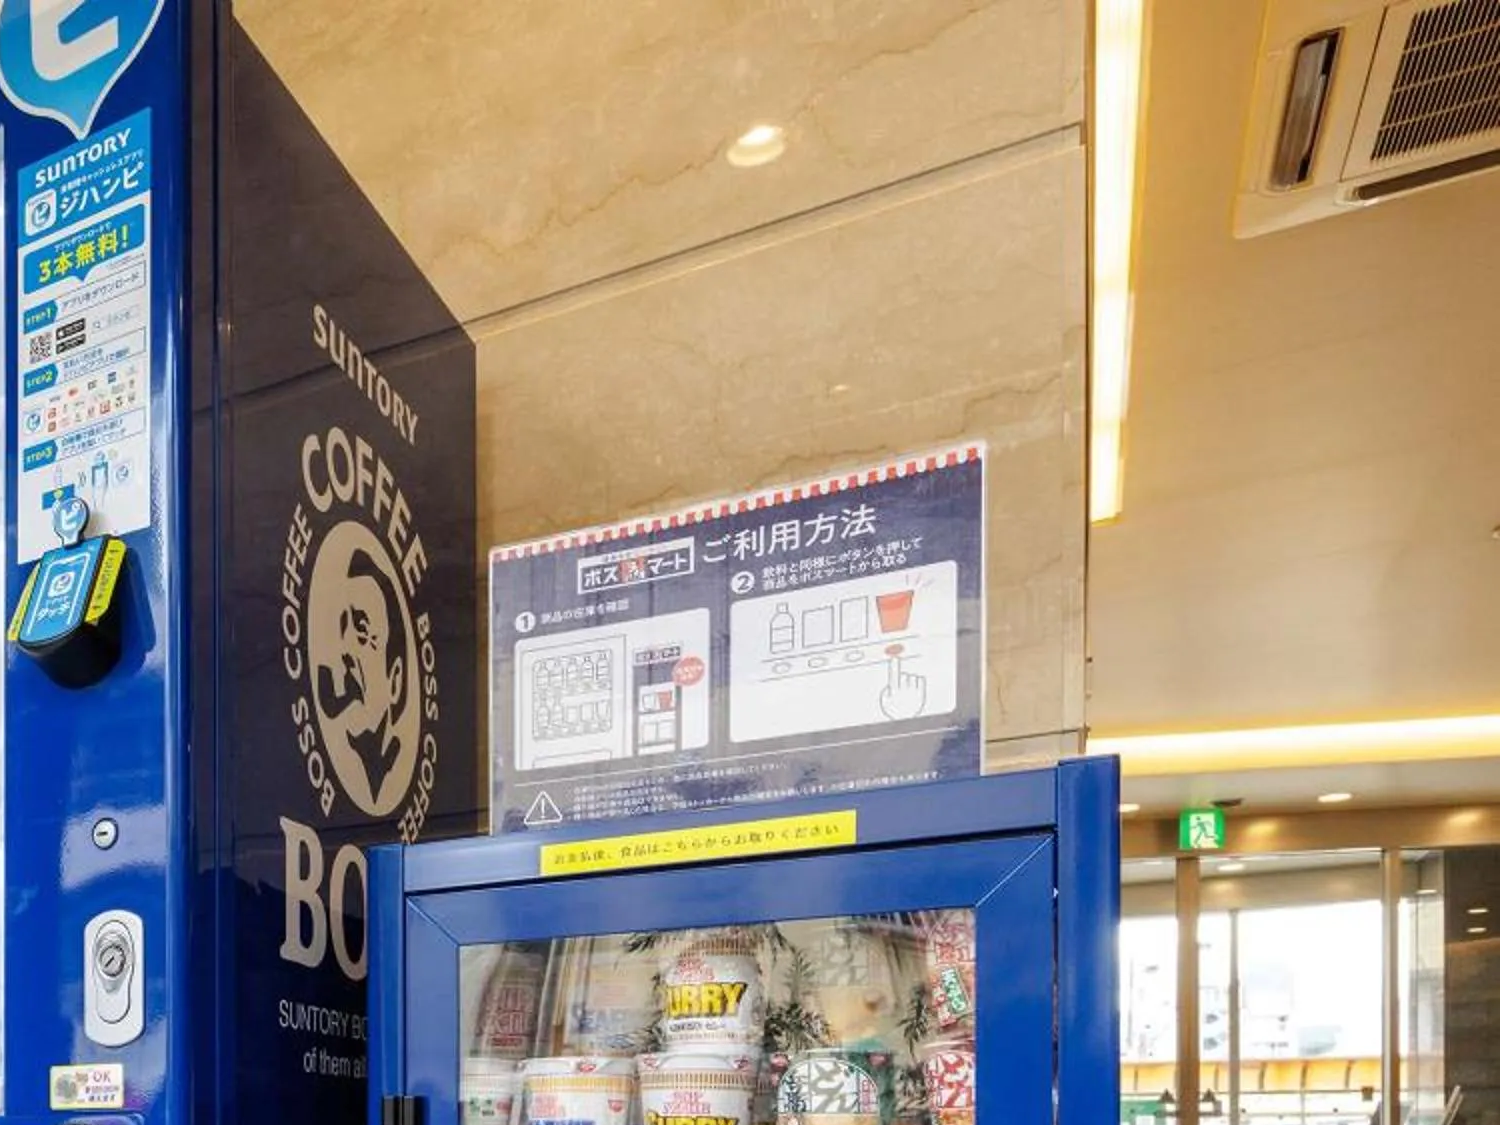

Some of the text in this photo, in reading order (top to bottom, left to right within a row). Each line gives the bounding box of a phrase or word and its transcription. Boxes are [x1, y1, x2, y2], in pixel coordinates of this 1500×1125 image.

[35, 128, 132, 188] SUNTORY
[60, 161, 145, 219] ジハンピ
[312, 304, 420, 446] SUNTORY
[302, 426, 428, 597] COFFEE
[702, 504, 878, 564] ご利用方法
[283, 502, 335, 818] BOSS COFFEE
[415, 611, 439, 721] BOSS
[280, 816, 368, 982] BO
[279, 1000, 349, 1035] SUNTORY
[665, 982, 748, 1018] URRY
[303, 1047, 317, 1074] of
[319, 1048, 351, 1077] them
